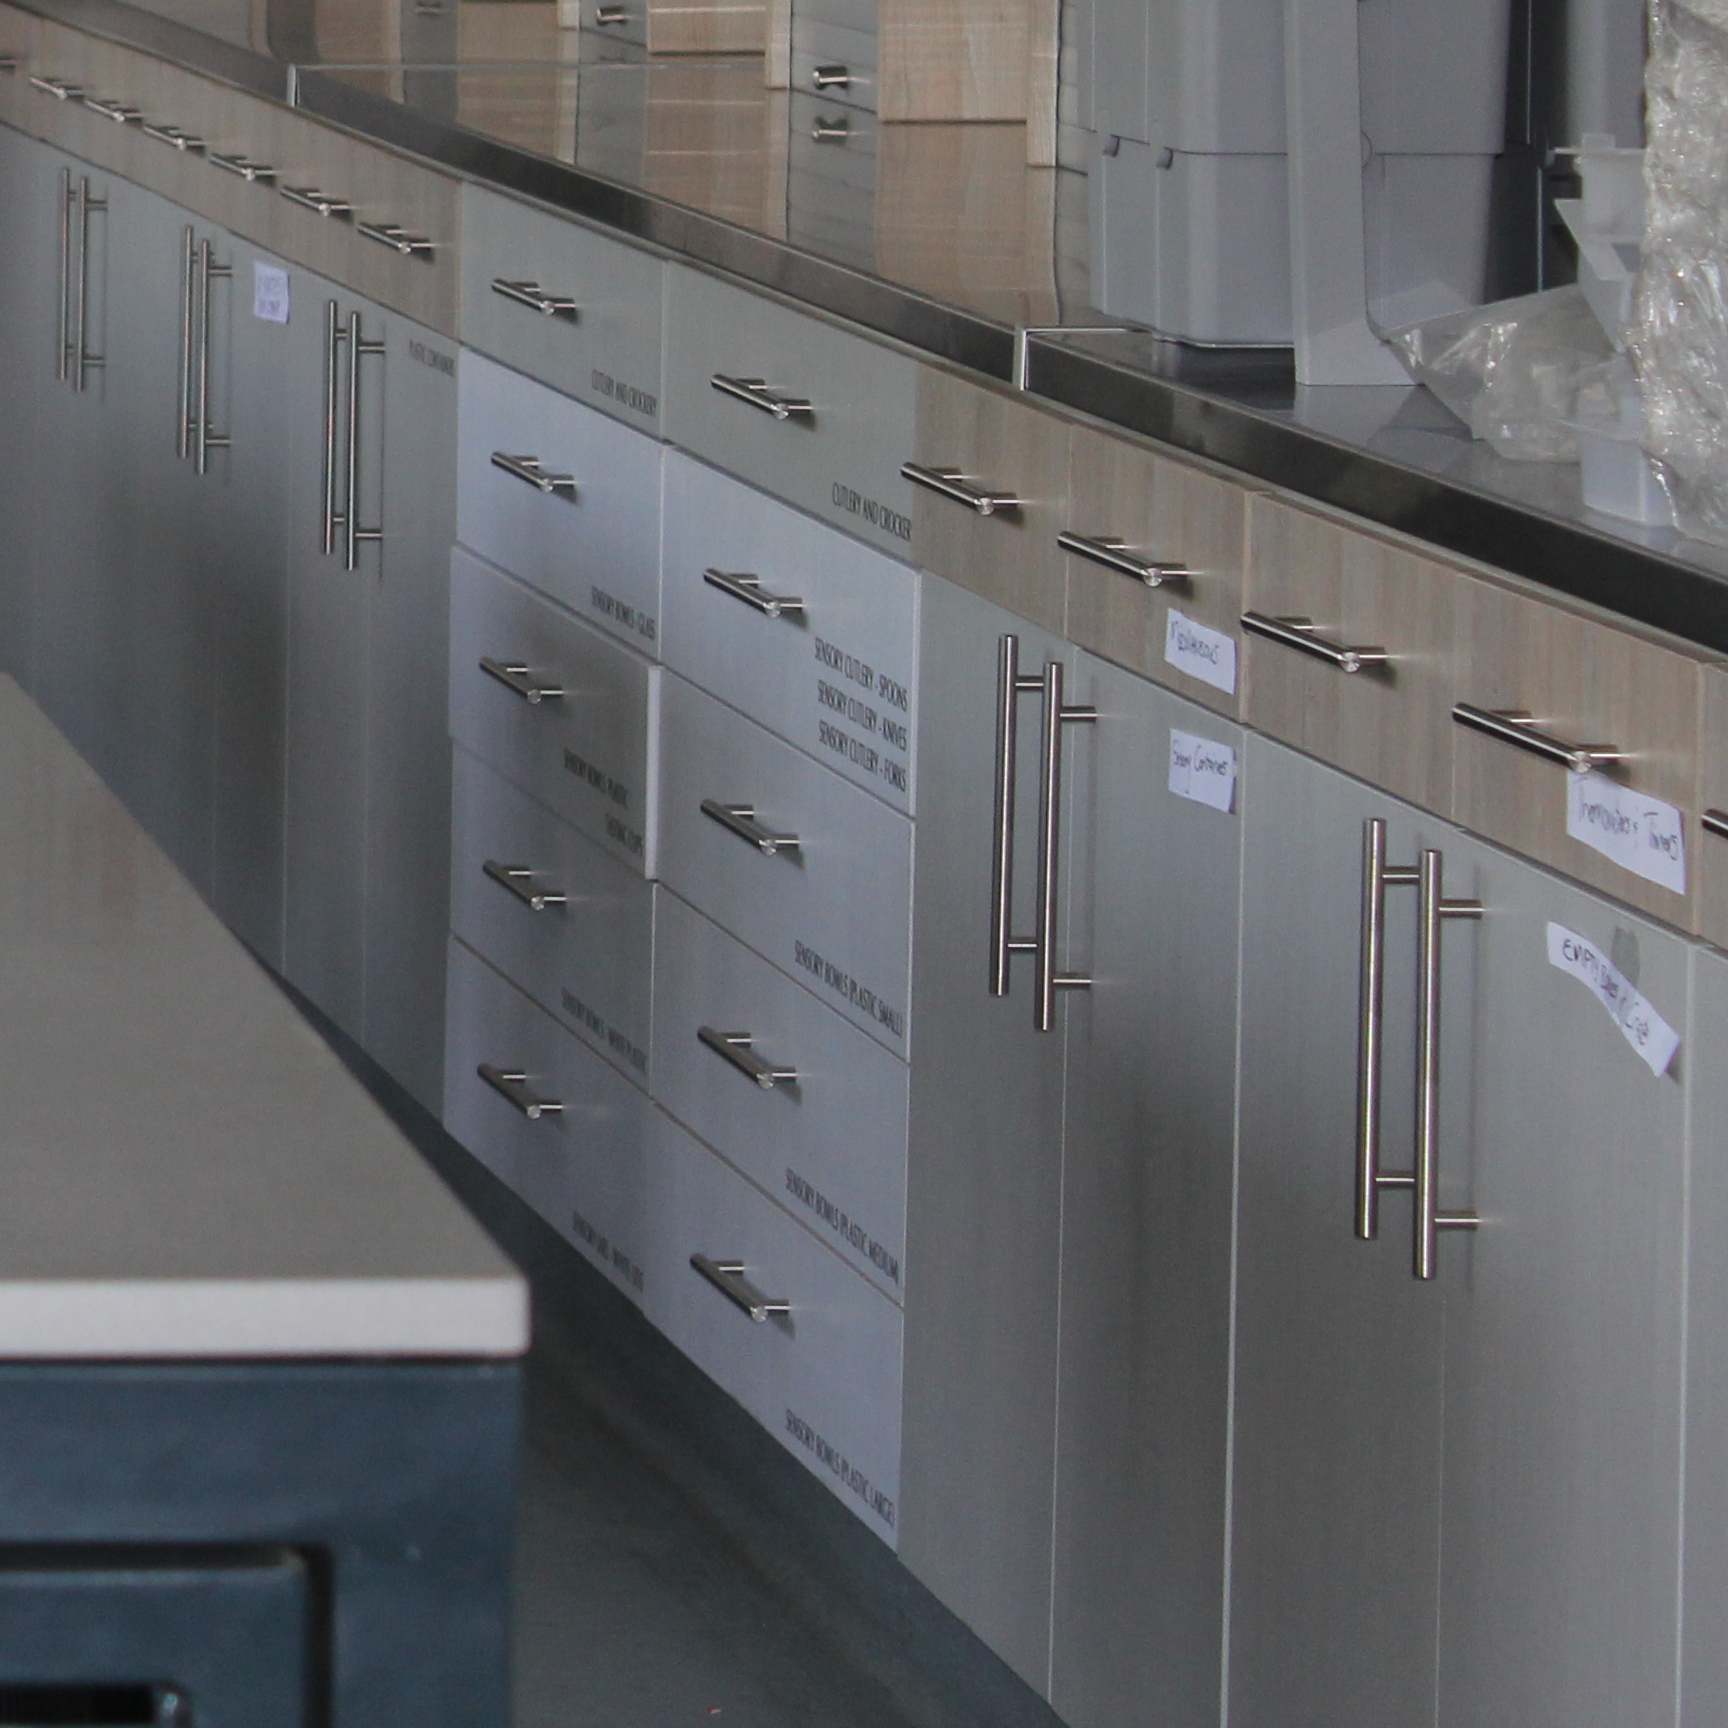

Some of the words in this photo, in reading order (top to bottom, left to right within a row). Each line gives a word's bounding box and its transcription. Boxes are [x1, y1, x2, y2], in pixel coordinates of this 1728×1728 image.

[832, 482, 861, 516] CUTLERY
[863, 498, 879, 525] AND
[814, 636, 843, 673] SENSORY
[844, 654, 874, 691] CUTLERY
[879, 673, 908, 713] SPOONS
[817, 679, 846, 716] SENSORY
[847, 697, 877, 734] CUTLERY
[882, 716, 907, 752] KNIVES
[819, 719, 848, 757] SENSORY
[849, 737, 879, 775] CUTLERY
[884, 757, 906, 793] FORKS
[795, 939, 824, 980] SENSORY
[824, 961, 848, 999] BOWLS
[785, 1167, 815, 1210] SENSORY
[815, 1190, 839, 1231] BOWLS
[785, 1408, 815, 1451] SENSORY
[815, 1434, 839, 1476] BOWLS
